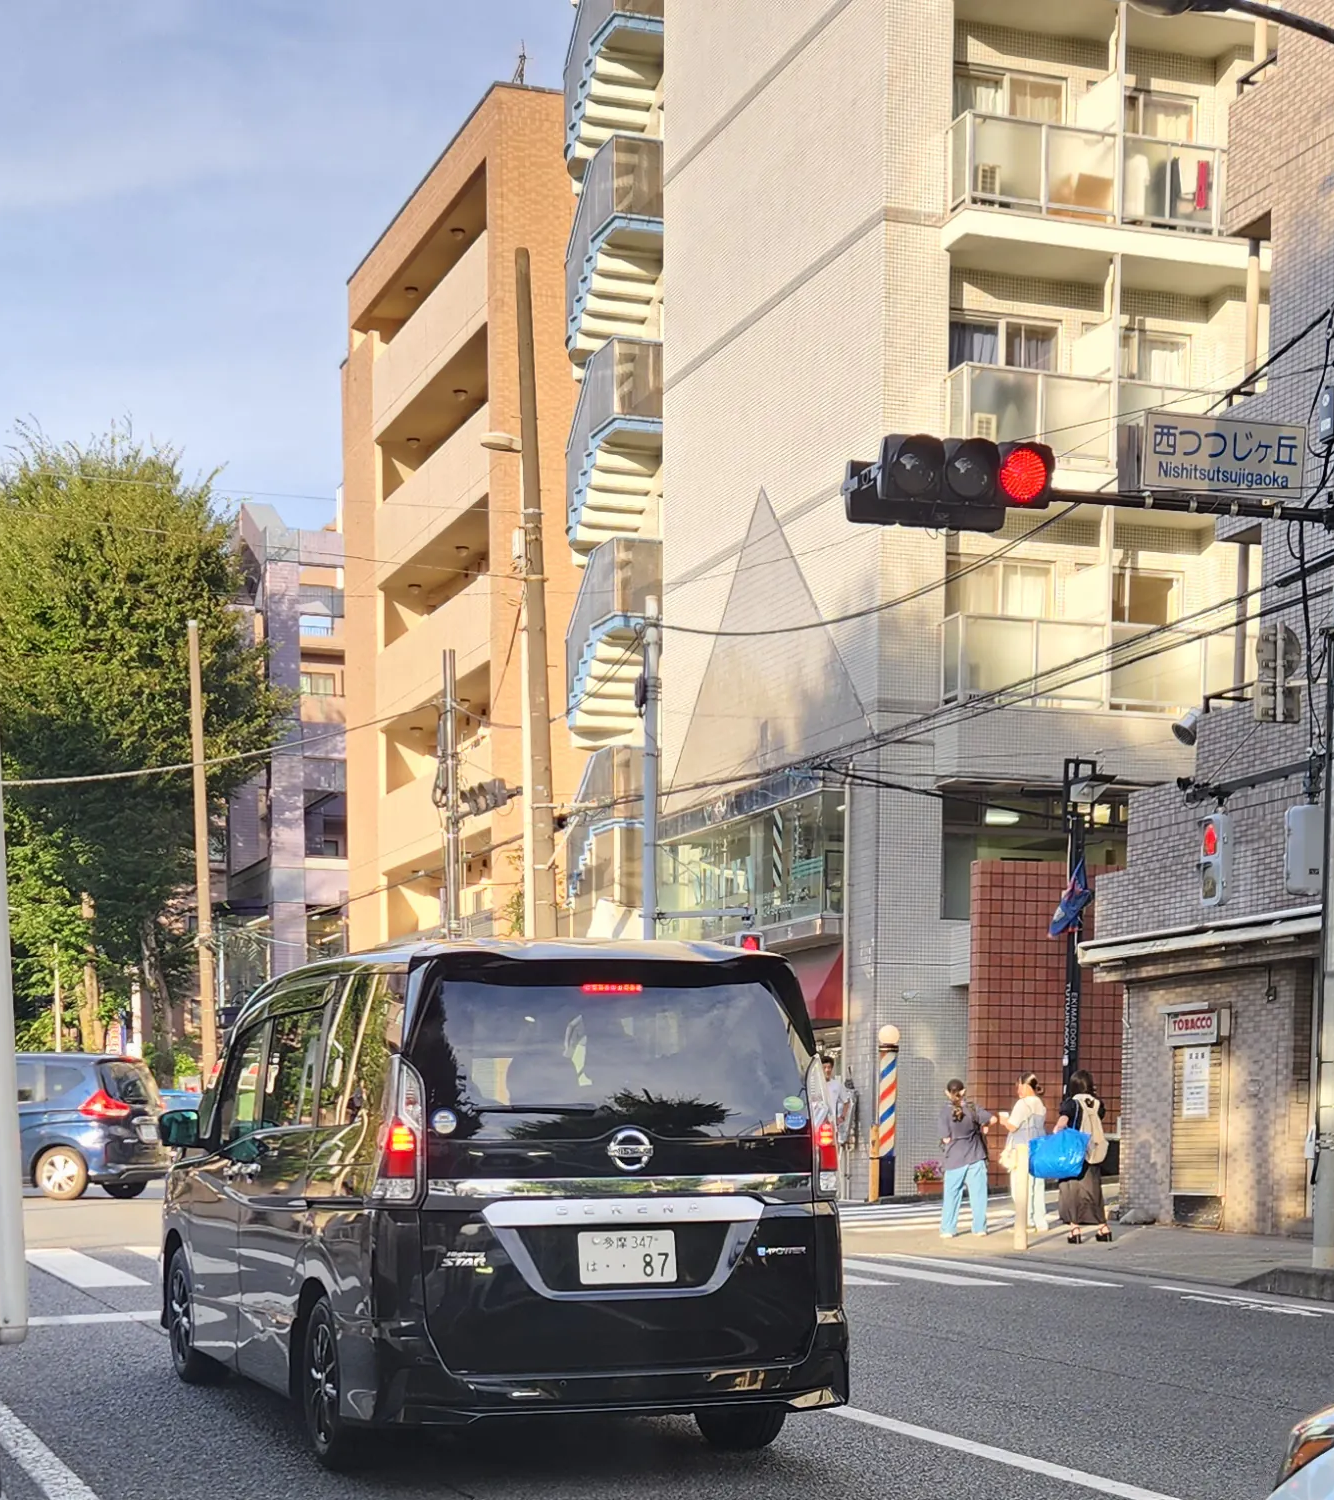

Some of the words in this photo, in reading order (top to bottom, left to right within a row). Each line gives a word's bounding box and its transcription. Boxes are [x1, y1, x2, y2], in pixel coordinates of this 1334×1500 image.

[1158, 460, 1289, 488] Nishitsutsujigaoka
[1070, 992, 1079, 1051] EKIMAEDORI
[1172, 1016, 1213, 1031] TOBACCO
[555, 1202, 701, 1216] SERENA
[603, 1236, 628, 1250] 多摩
[631, 1235, 654, 1249] 347
[440, 1257, 487, 1267] STAR
[586, 1261, 598, 1272] は
[642, 1252, 670, 1278] 87
